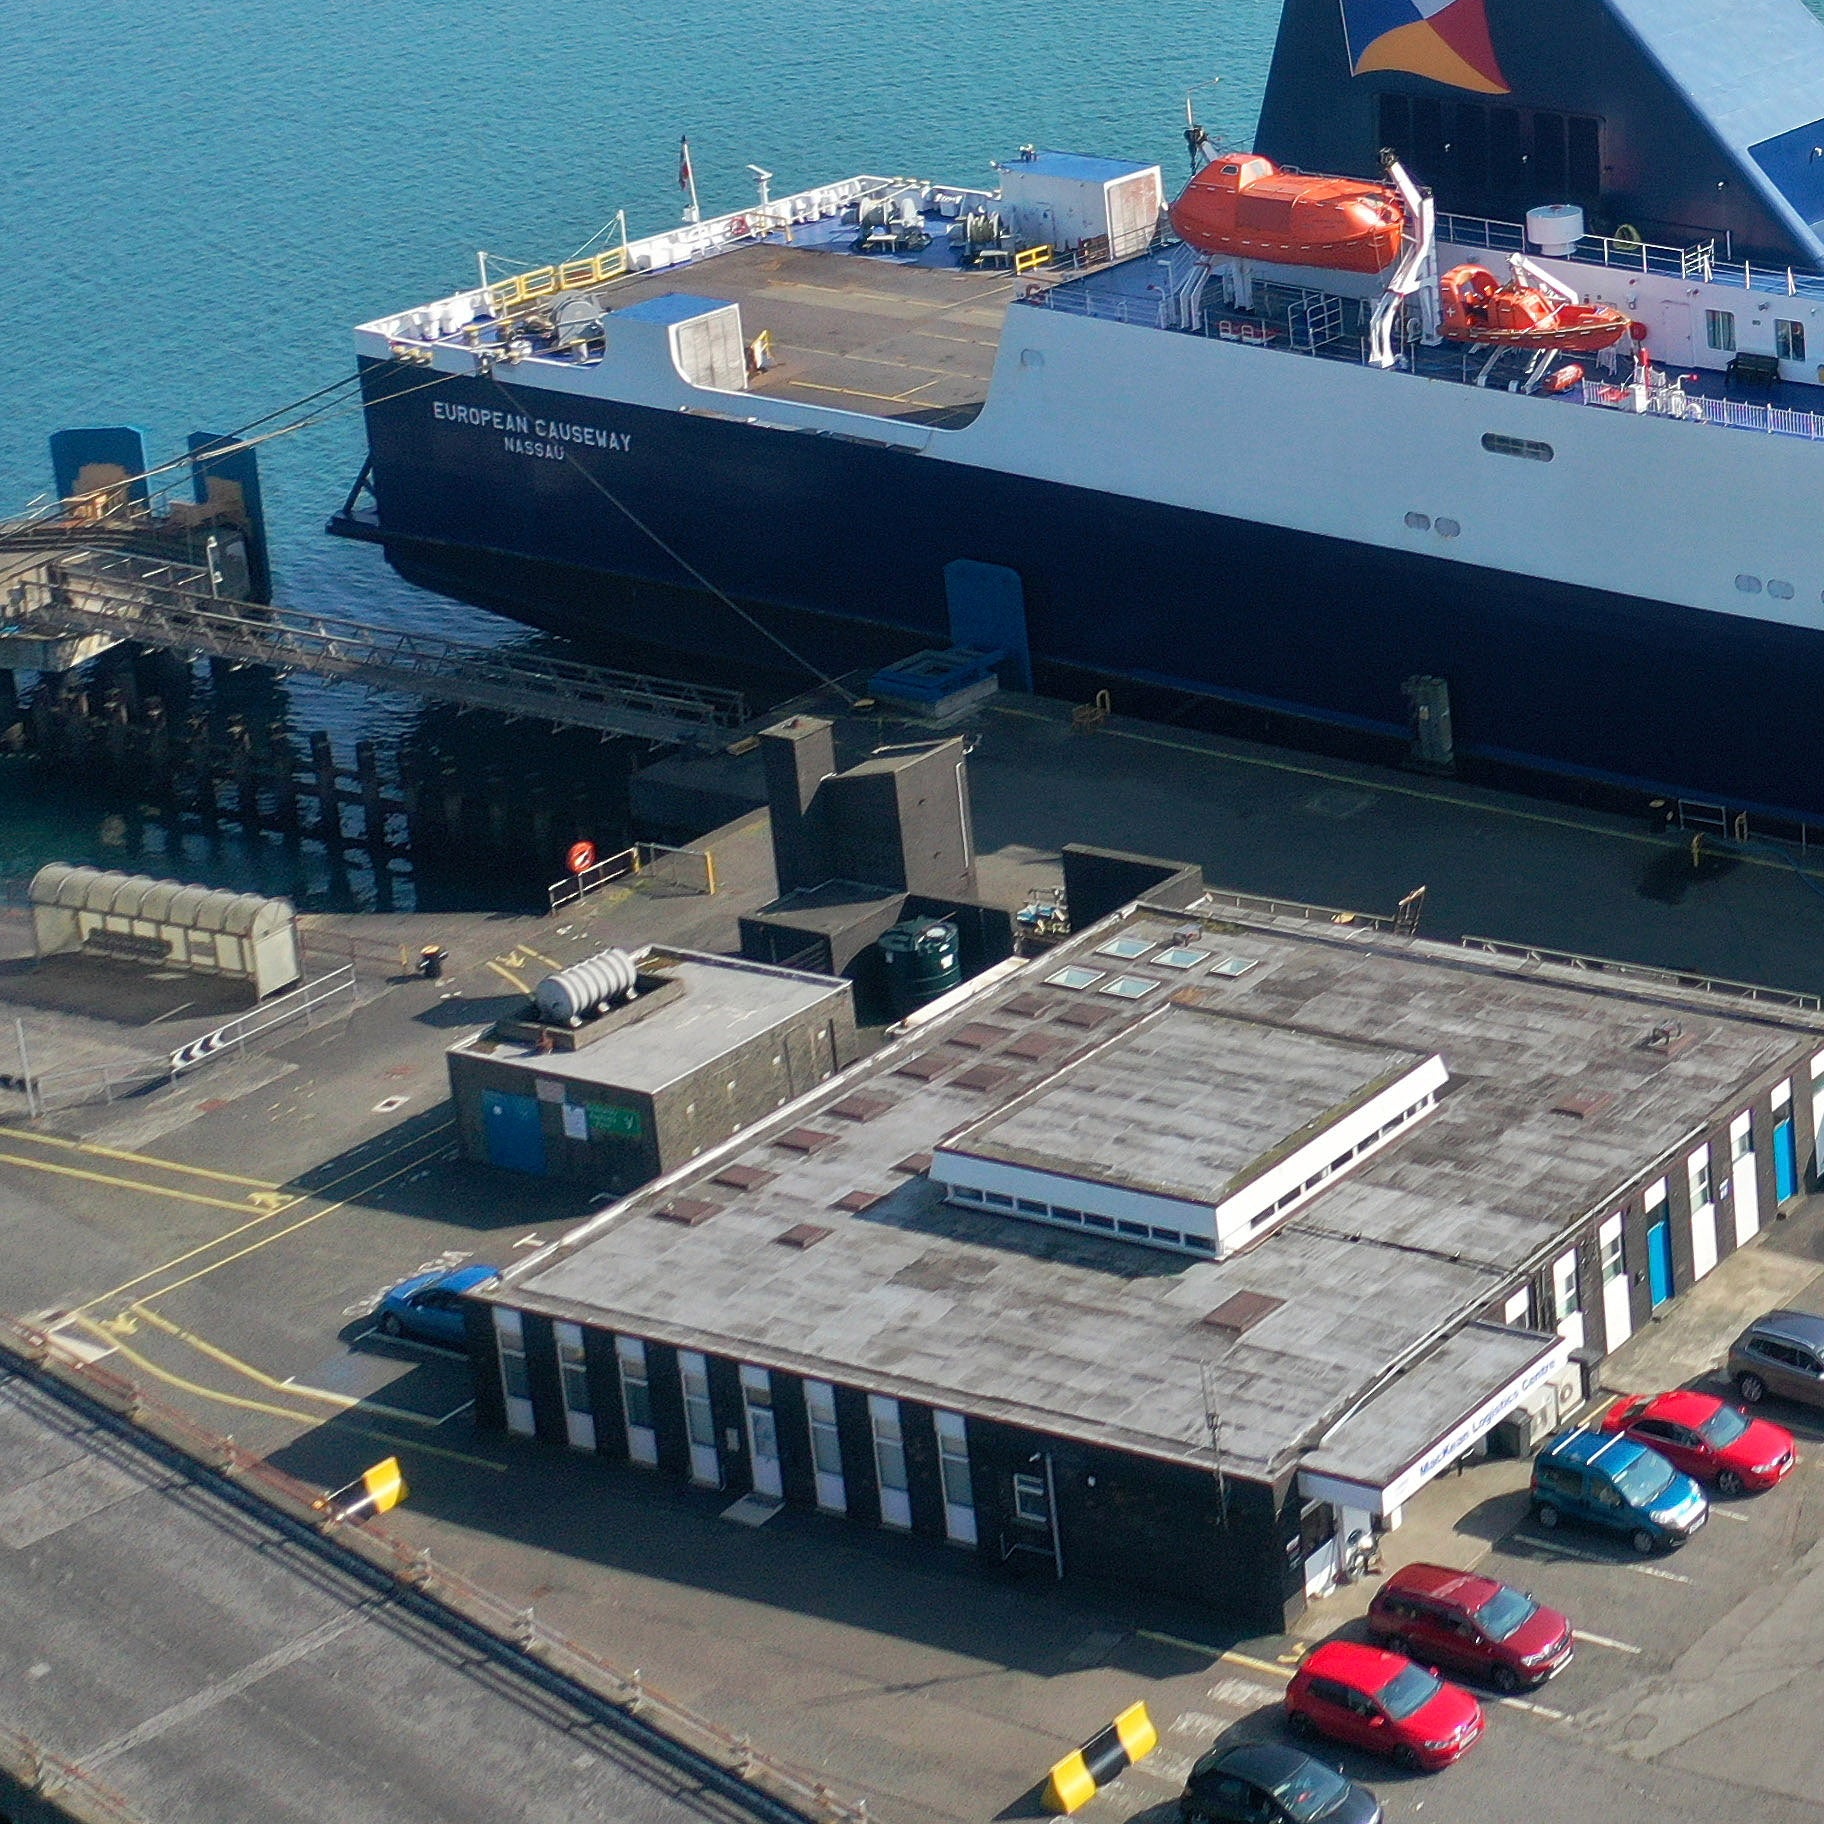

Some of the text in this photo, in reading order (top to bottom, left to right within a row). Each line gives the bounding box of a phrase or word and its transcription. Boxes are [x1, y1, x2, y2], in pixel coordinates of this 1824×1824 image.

[433, 401, 631, 452] EUROPEAN CAUSEWAY
[504, 436, 565, 460] NASSAU
[1471, 1389, 1519, 1435] Logistics
[1521, 1358, 1556, 1391] Centre
